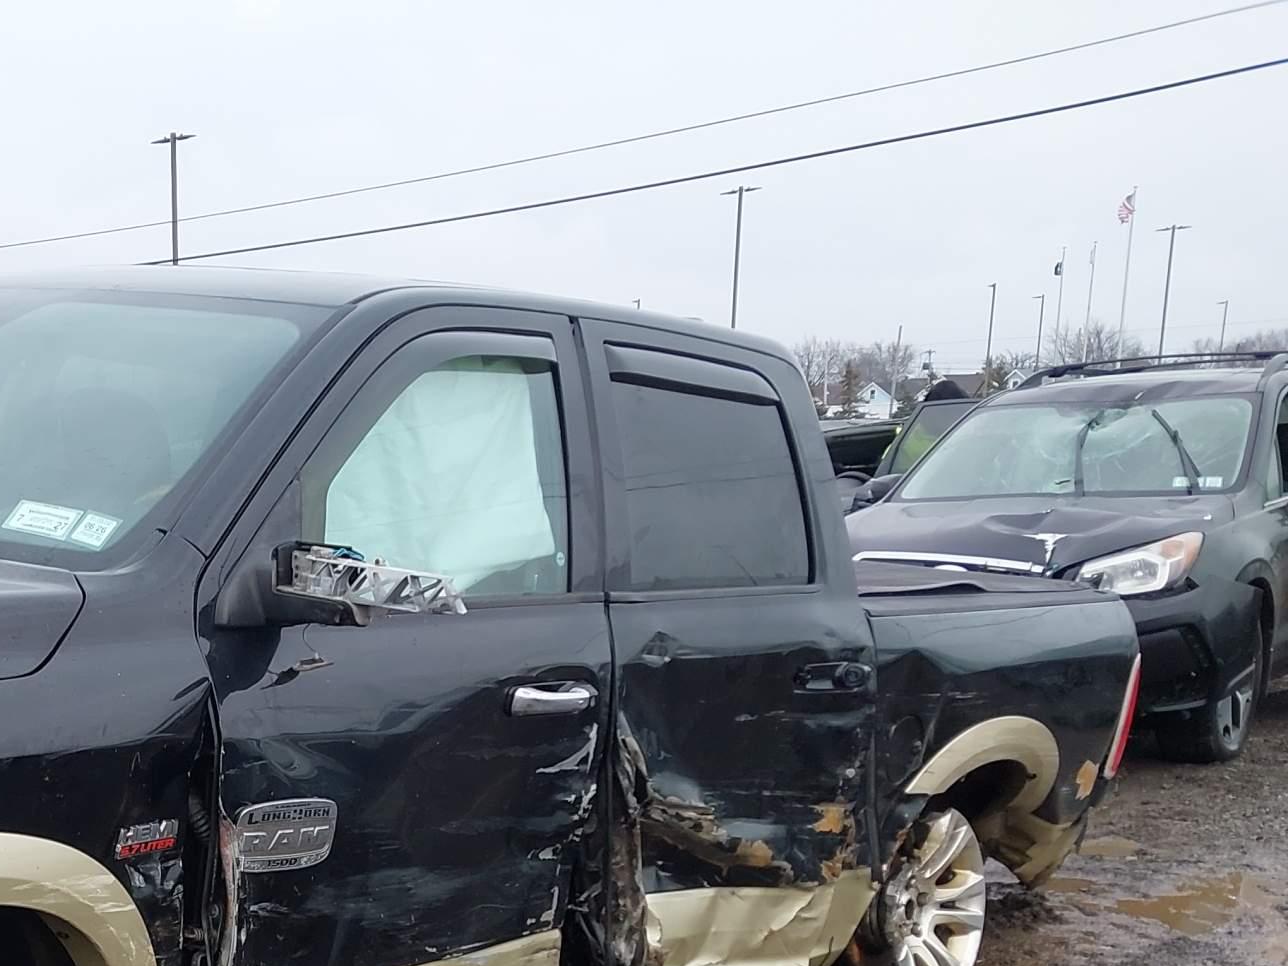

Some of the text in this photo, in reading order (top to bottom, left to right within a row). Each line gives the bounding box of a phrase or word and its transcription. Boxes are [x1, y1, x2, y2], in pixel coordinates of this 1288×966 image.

[119, 819, 179, 844] HEMI
[242, 825, 330, 852] RAM
[267, 857, 298, 867] 1500
